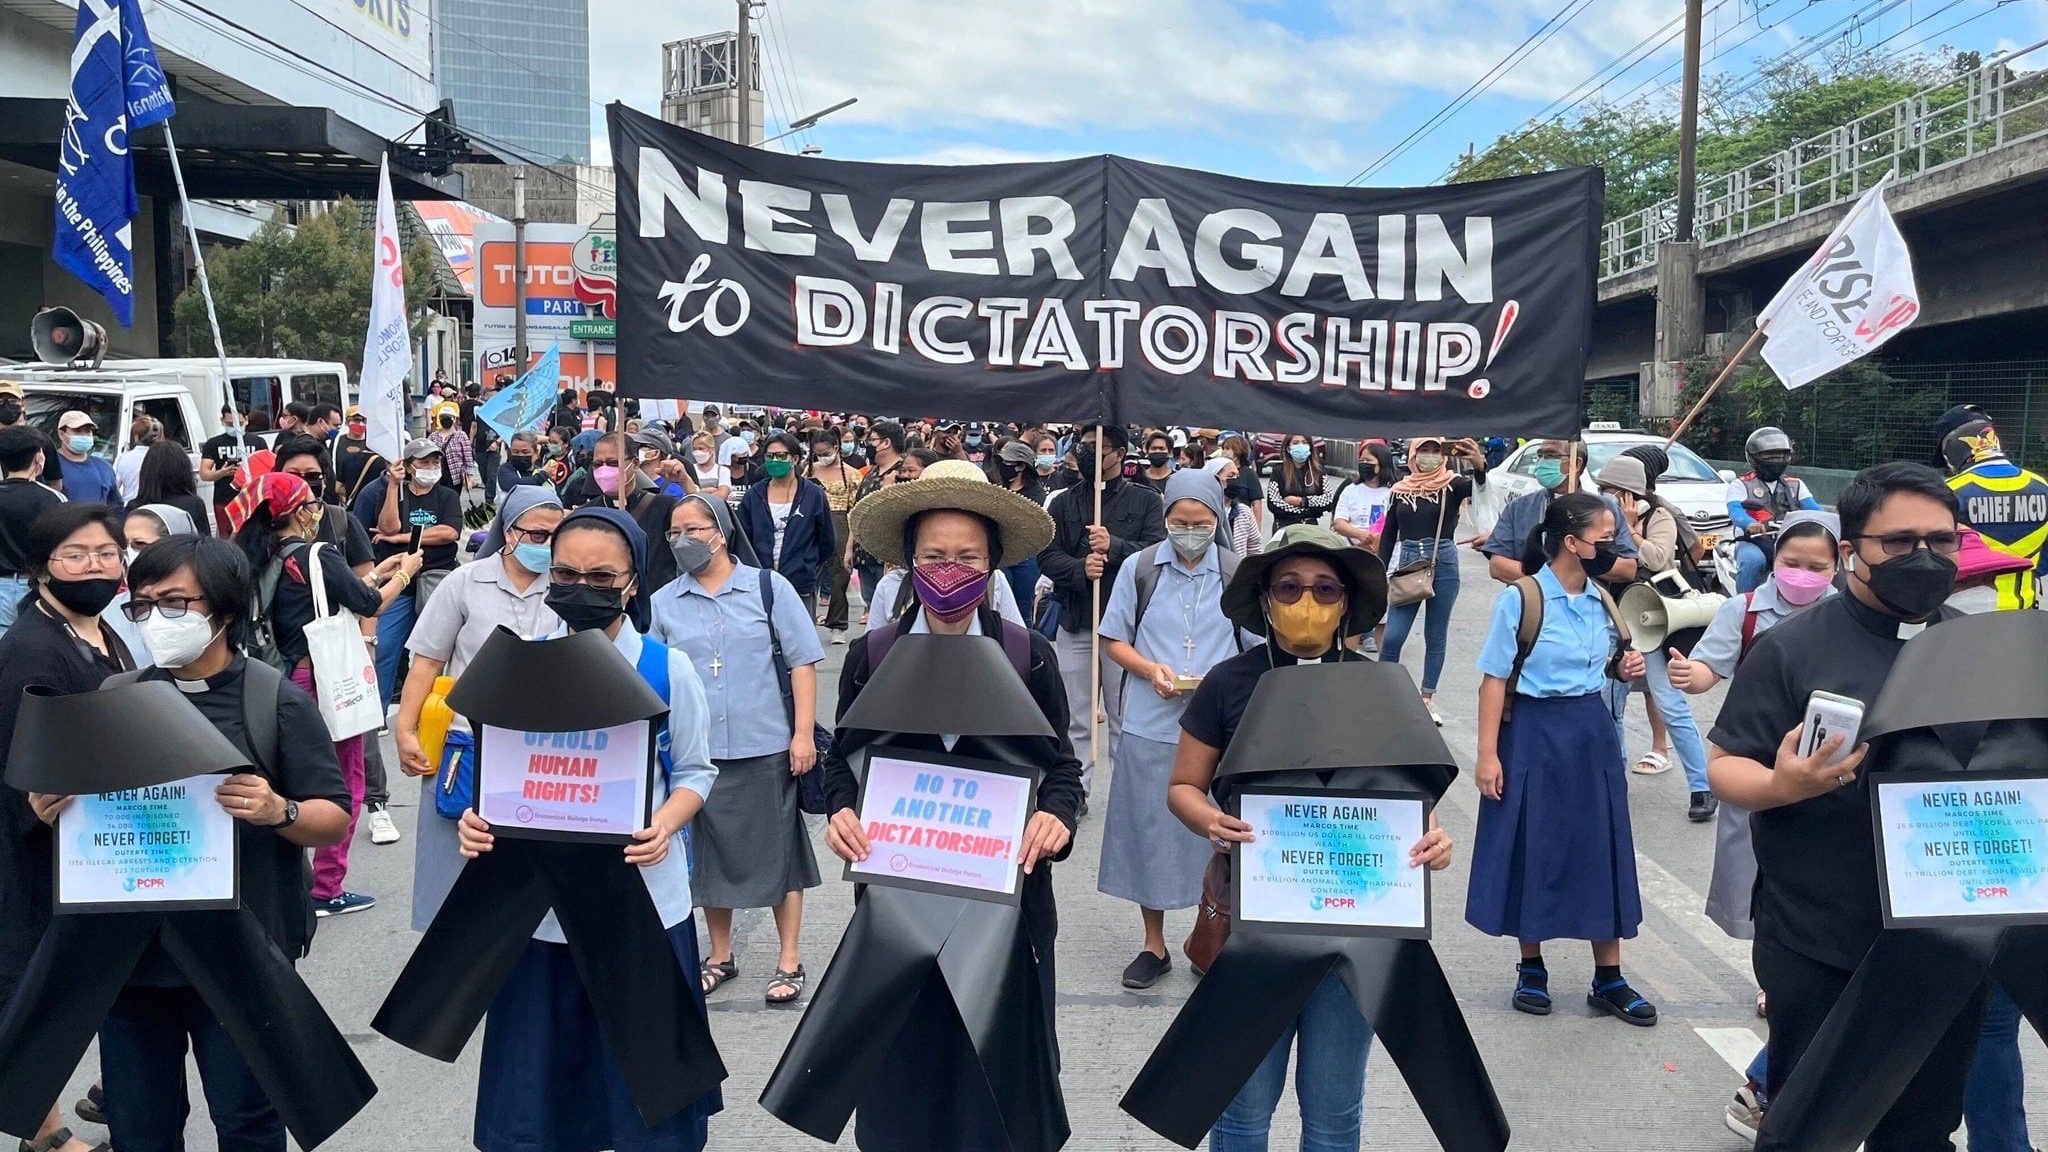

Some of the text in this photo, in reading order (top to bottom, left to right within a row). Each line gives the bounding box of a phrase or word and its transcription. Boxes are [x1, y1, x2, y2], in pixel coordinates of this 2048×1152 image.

[638, 147, 1494, 304] NEVER AGAIN
[62, 197, 82, 225] the
[76, 218, 132, 295] Philippines
[573, 325, 614, 334] ENTRANCE
[657, 253, 1519, 399] to DICTATORSHIP!
[1968, 495, 2047, 524] CHIEF MCU
[524, 731, 609, 750] UPHOLD
[528, 754, 598, 777] HUMAN
[99, 786, 186, 802] NEVER AGAIN!
[522, 780, 600, 804] RIGHTS!
[914, 773, 979, 799] NO TO
[1922, 790, 2022, 807] NEVER AGAIN!
[132, 812, 180, 820] IMPRISONED
[891, 797, 992, 829] ANOTHER
[1285, 804, 1377, 821] NEVER AGAIN!
[94, 831, 191, 846] NEVER FORGET!
[866, 821, 1012, 859] DICTATORSHIP!
[1924, 839, 2033, 857] NEVER FORGET!
[1281, 849, 1383, 867] NEVER FORGET!
[137, 878, 165, 888] PCPR
[1311, 887, 1354, 895] CONTRACT
[1977, 887, 2008, 897] PCPR
[1324, 897, 1356, 908] PCPR
